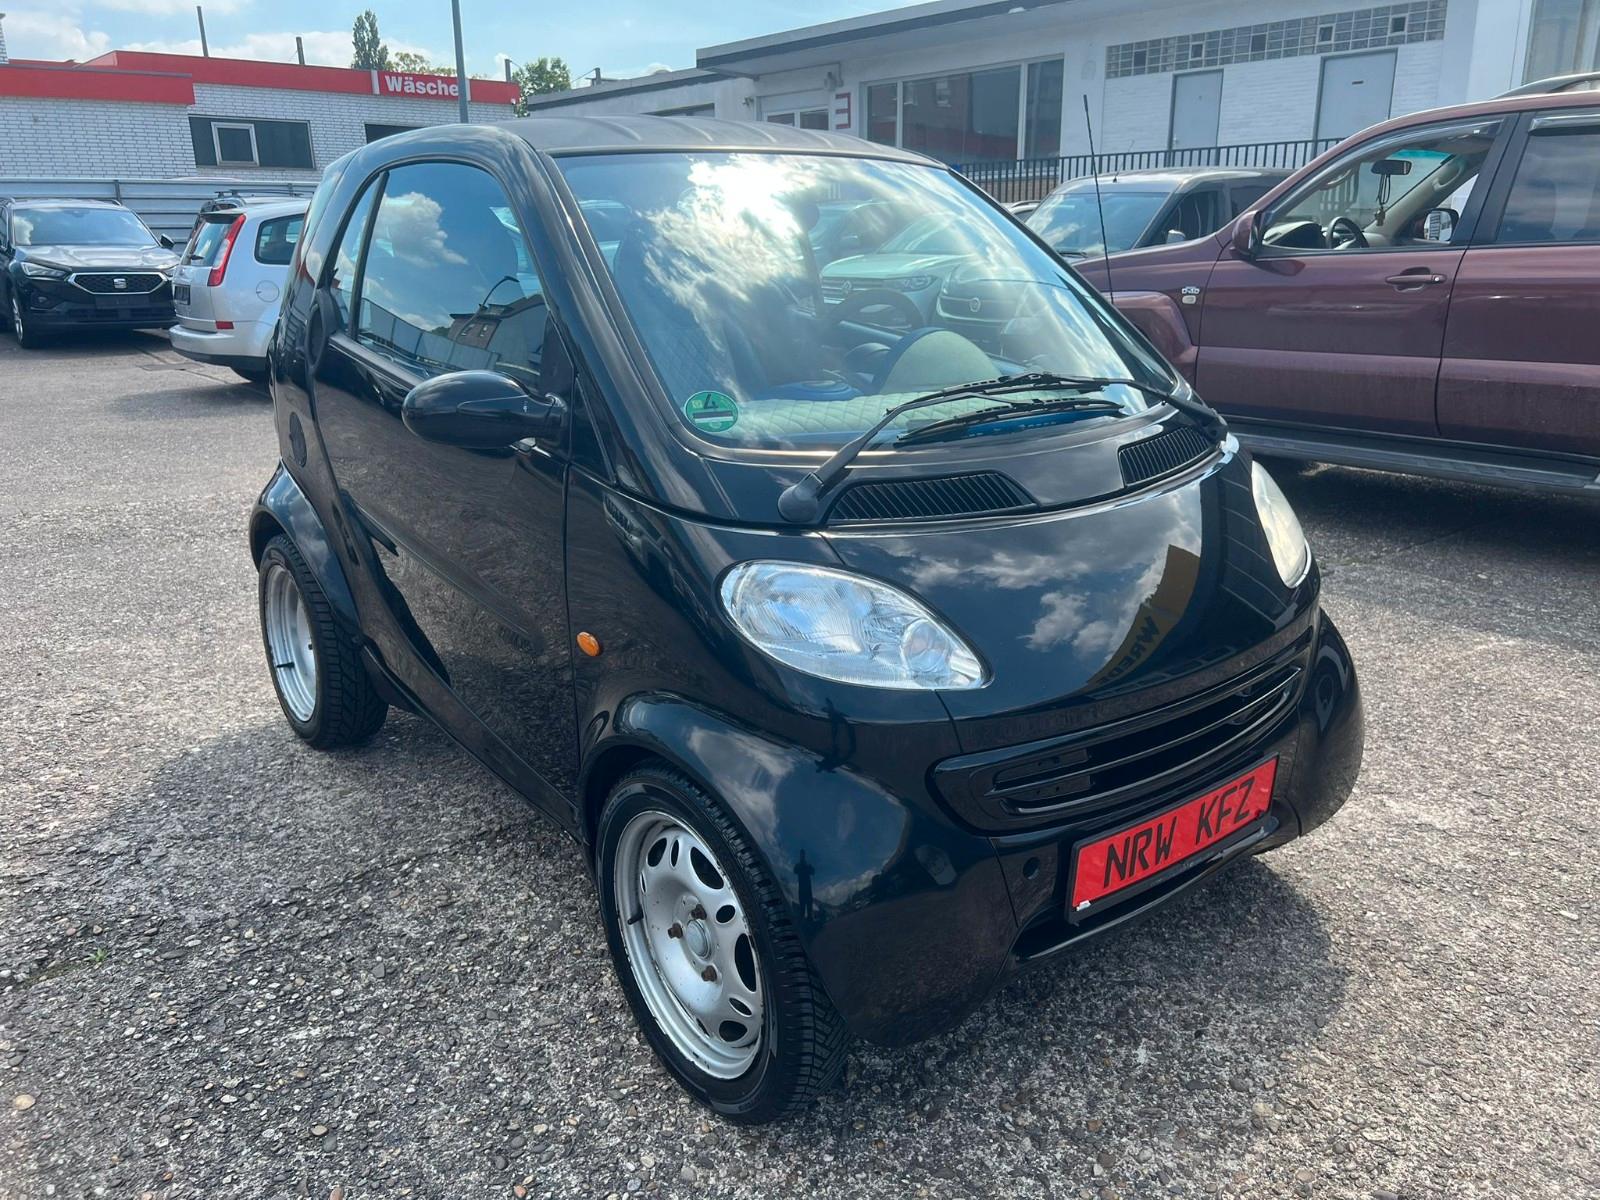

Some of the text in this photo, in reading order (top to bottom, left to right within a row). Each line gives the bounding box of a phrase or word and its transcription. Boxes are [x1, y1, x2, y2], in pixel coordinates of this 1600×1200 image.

[385, 75, 459, 96] Wäsche
[703, 393, 720, 410] 4
[1103, 776, 1255, 889] NRW KFZ
